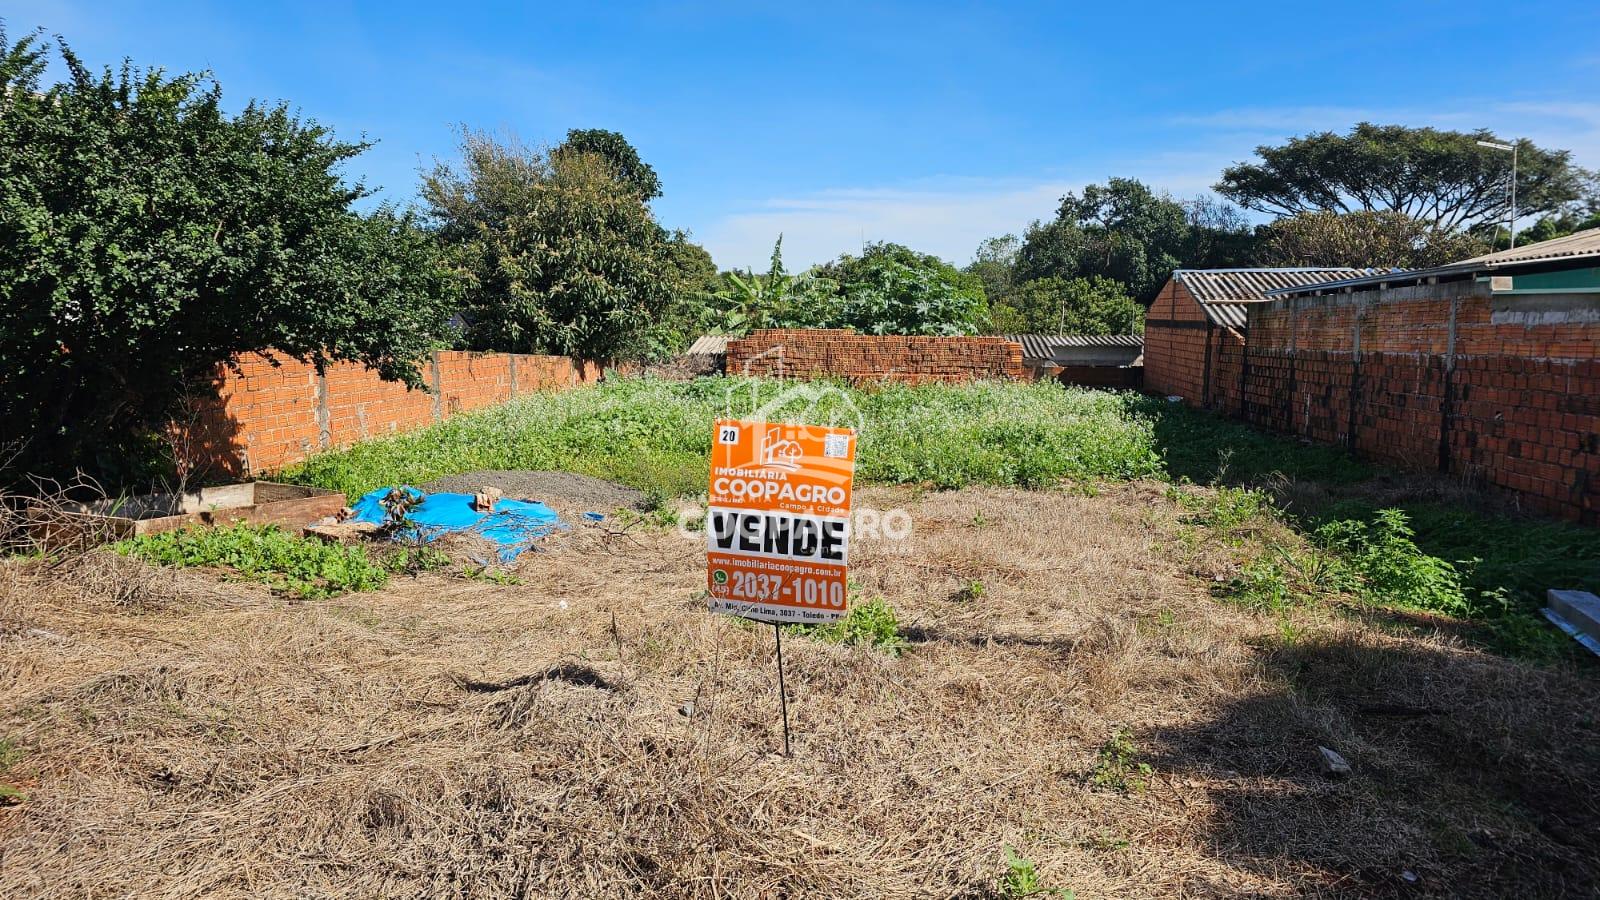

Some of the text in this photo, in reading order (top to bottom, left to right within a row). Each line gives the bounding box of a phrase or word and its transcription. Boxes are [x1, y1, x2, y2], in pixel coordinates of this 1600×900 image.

[722, 430, 735, 442] 20
[714, 467, 788, 481] IMOBILIÁRIA
[713, 477, 846, 505] COOPAGRO
[779, 502, 807, 511] Campo
[712, 511, 844, 561] VENDE
[712, 557, 842, 578] www.imobiliariacoopagro.com.br
[732, 570, 844, 607] 2037-1010
